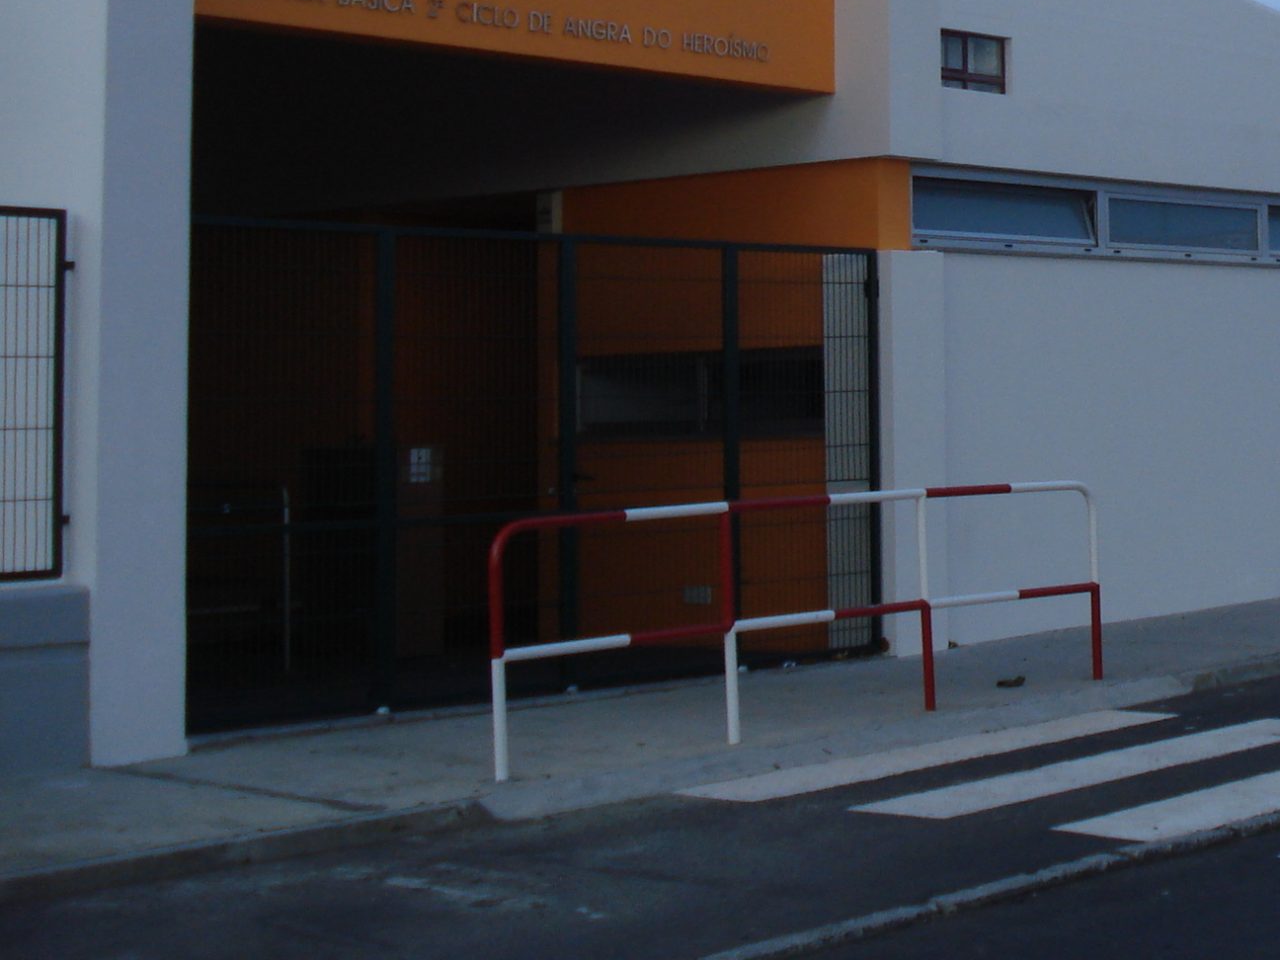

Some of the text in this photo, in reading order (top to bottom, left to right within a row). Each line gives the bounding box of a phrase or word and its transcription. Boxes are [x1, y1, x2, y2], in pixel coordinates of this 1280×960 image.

[455, 0, 521, 30] CICLO
[529, 10, 553, 33] DE
[564, 17, 632, 44] ANGRA
[643, 26, 672, 49] DO
[683, 32, 770, 62] HEROÍSMO
